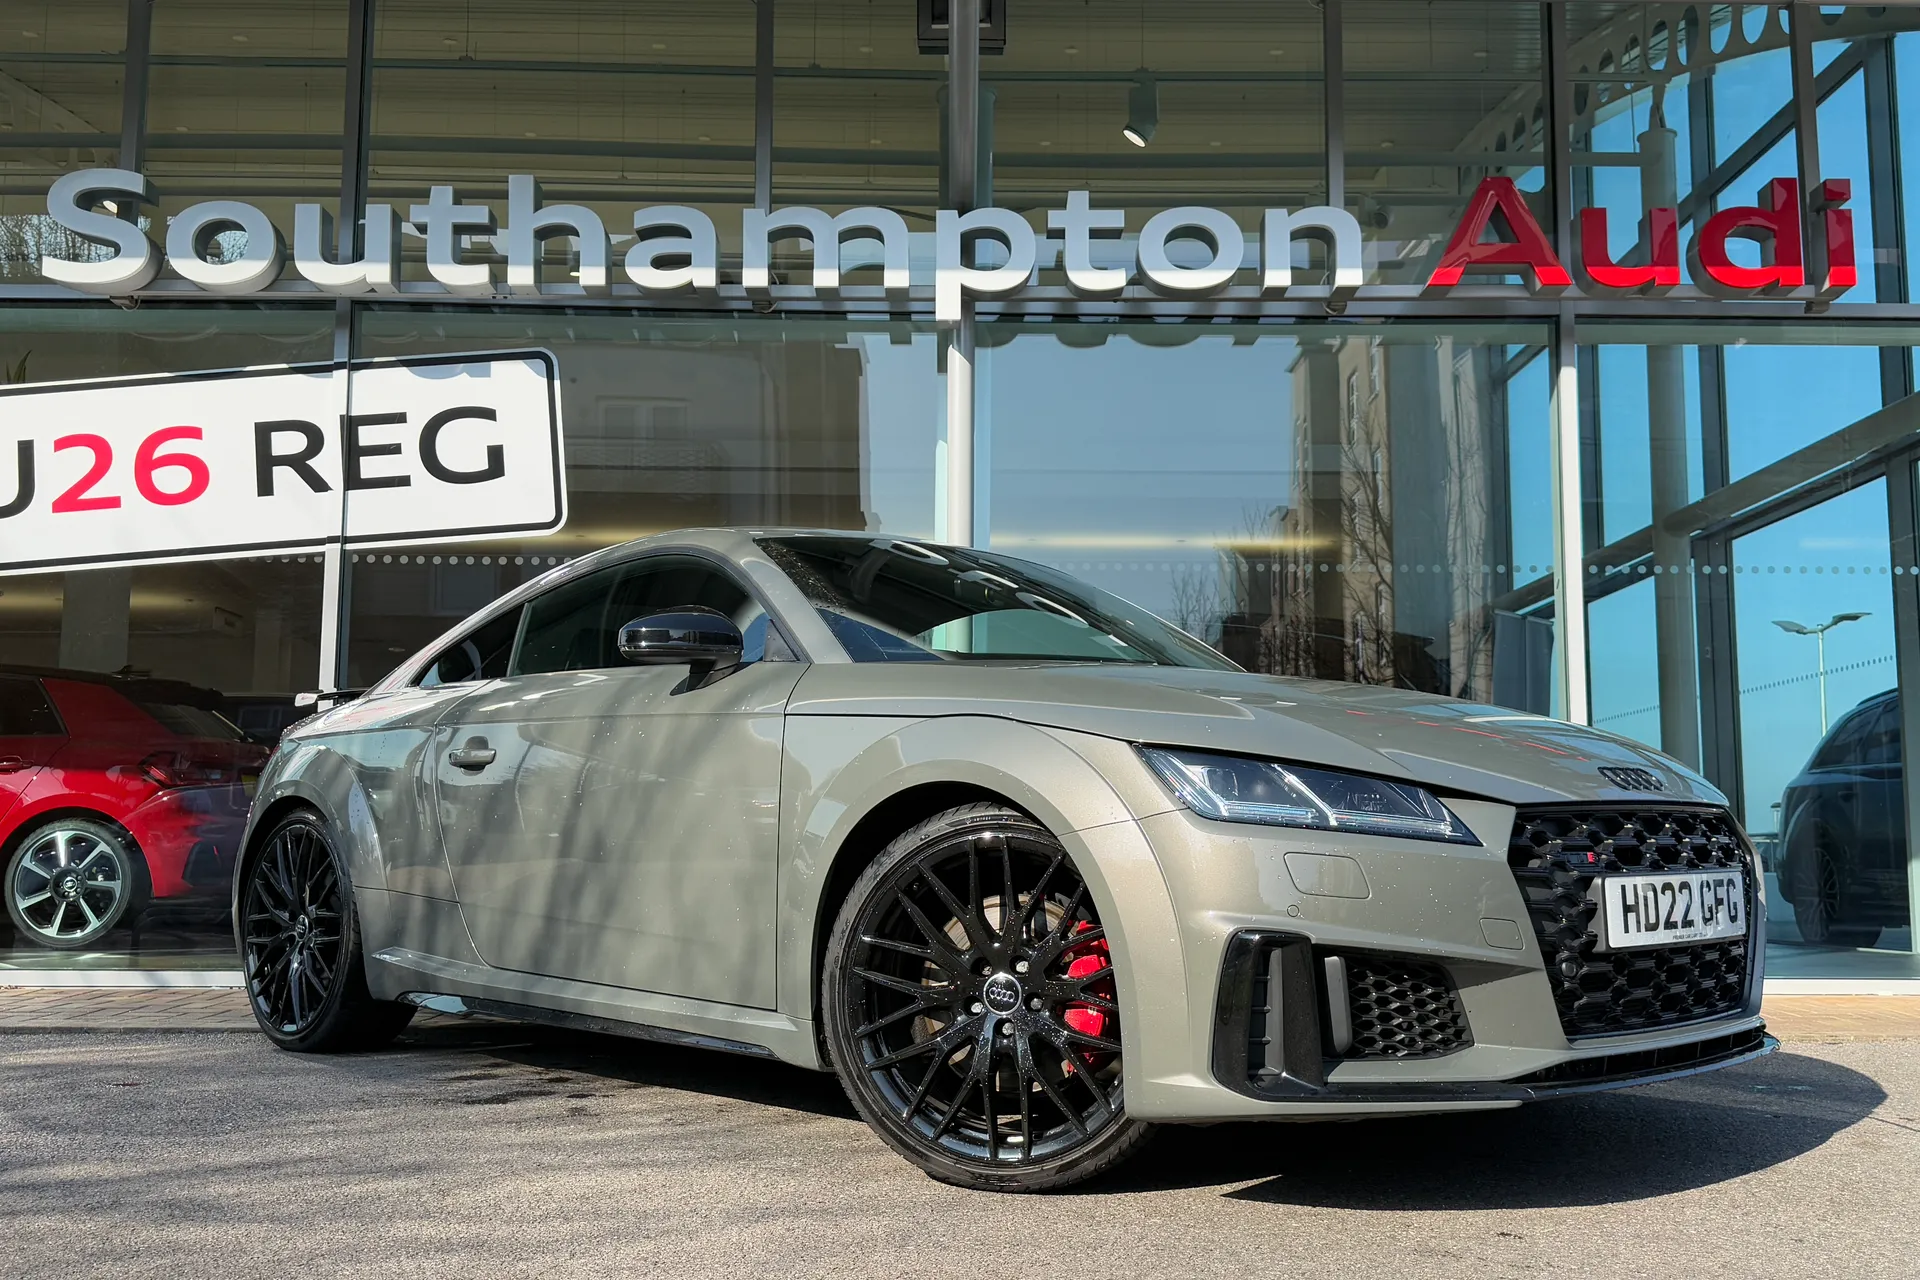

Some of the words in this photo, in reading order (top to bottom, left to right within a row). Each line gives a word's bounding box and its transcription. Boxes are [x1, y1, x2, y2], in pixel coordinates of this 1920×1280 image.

[42, 168, 1363, 322] Southampton
[1428, 177, 1857, 291] Audi
[254, 406, 506, 498] REG
[1620, 880, 1695, 935] HD22
[1699, 877, 1739, 927] GFG
